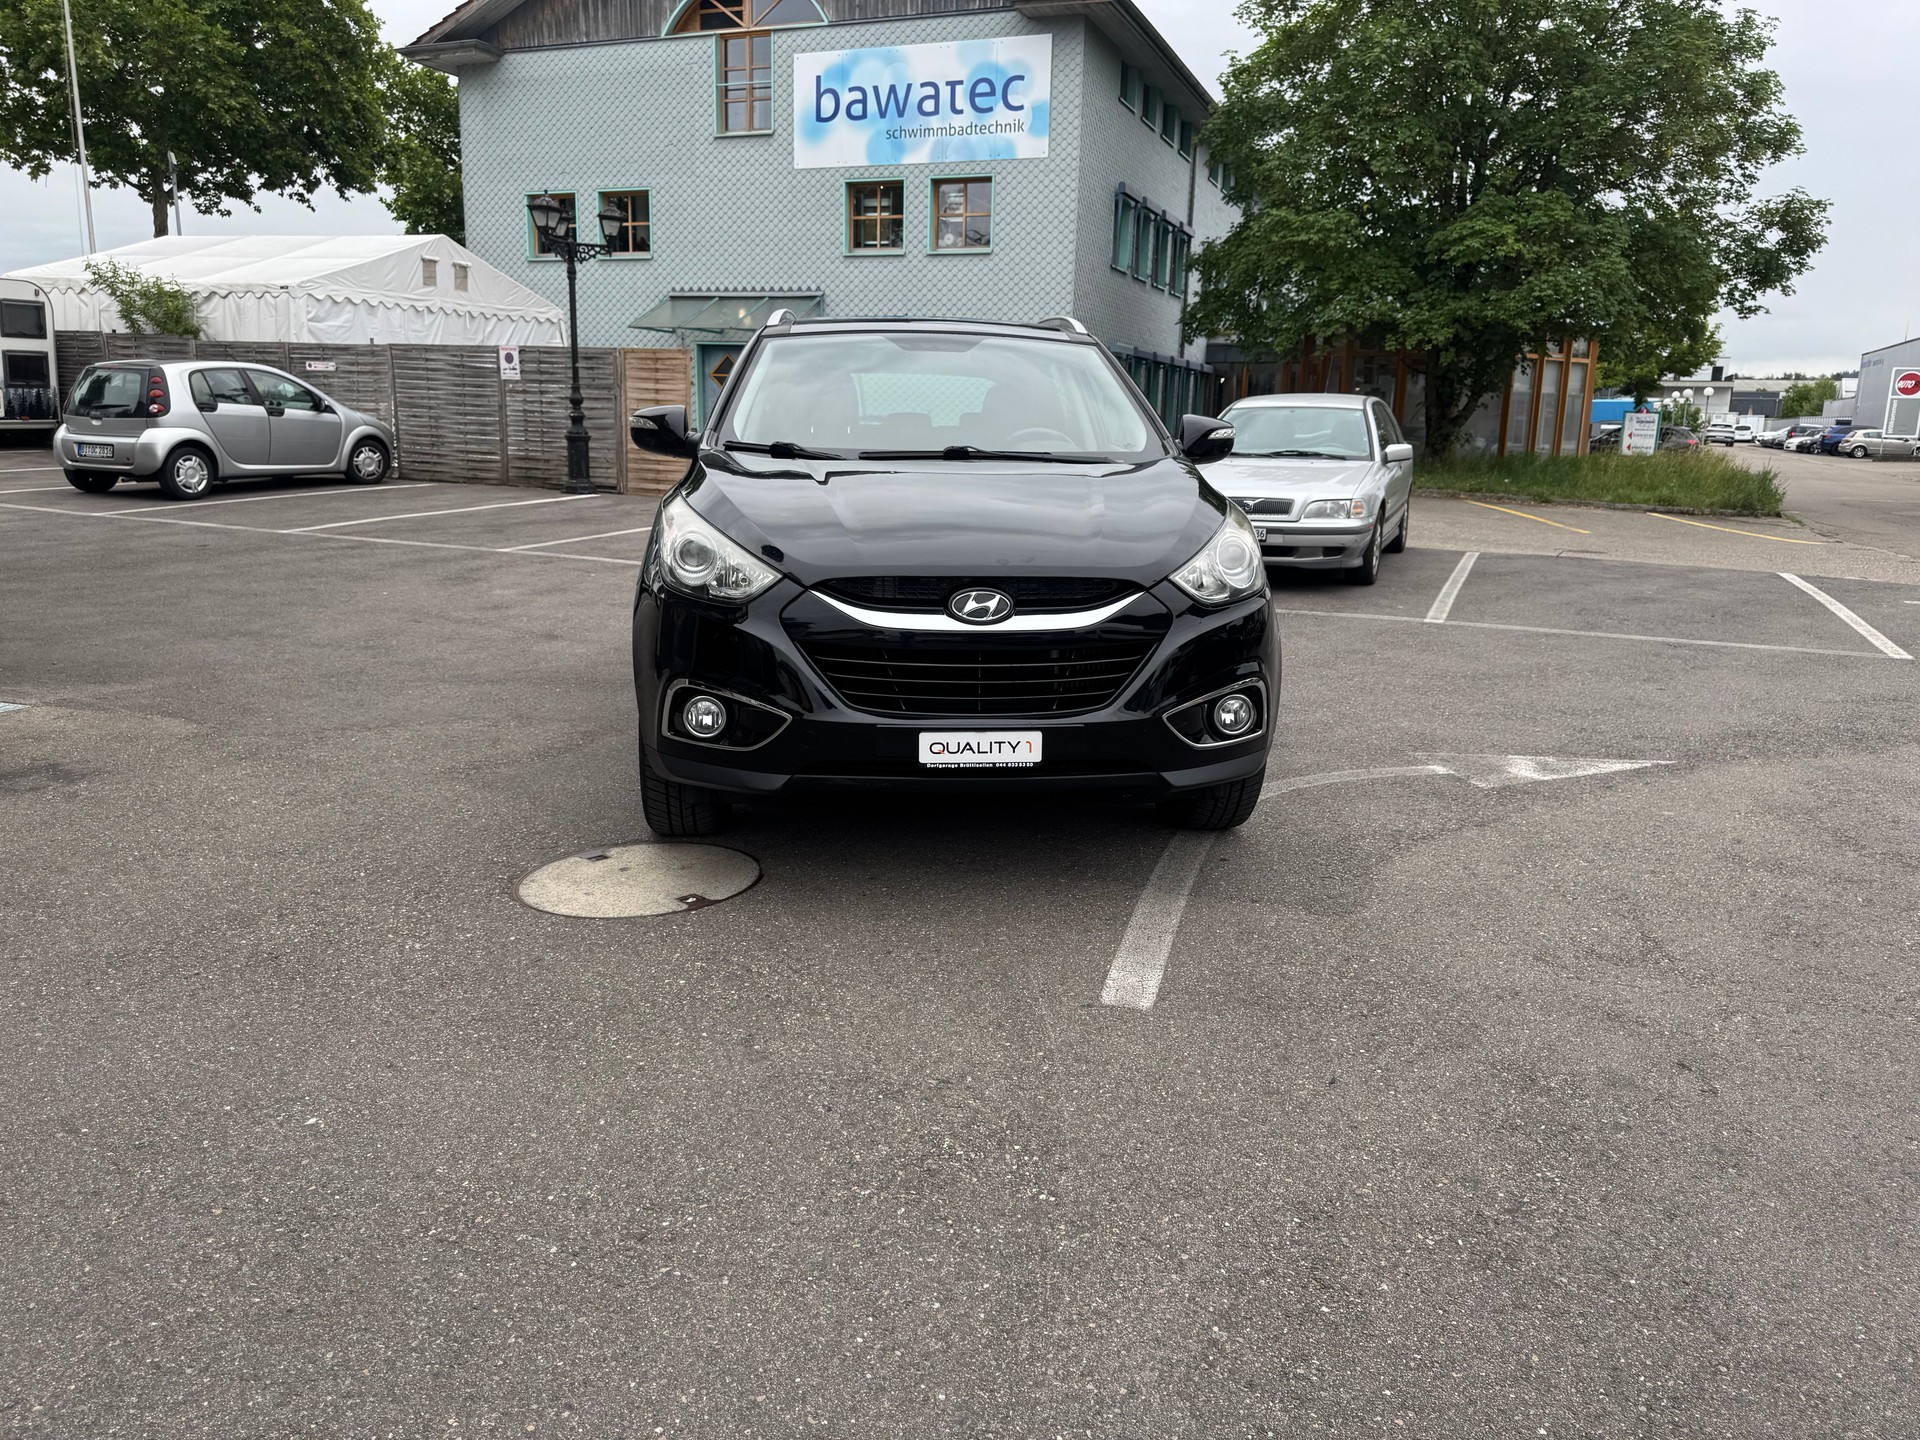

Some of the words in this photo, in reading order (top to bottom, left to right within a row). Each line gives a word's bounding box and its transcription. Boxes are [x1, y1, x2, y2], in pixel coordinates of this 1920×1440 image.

[815, 74, 1025, 123] bawatec
[885, 118, 1025, 141] schwimmbadtechnik
[929, 740, 1021, 755] QUALITY
[1025, 740, 1033, 754] 1
